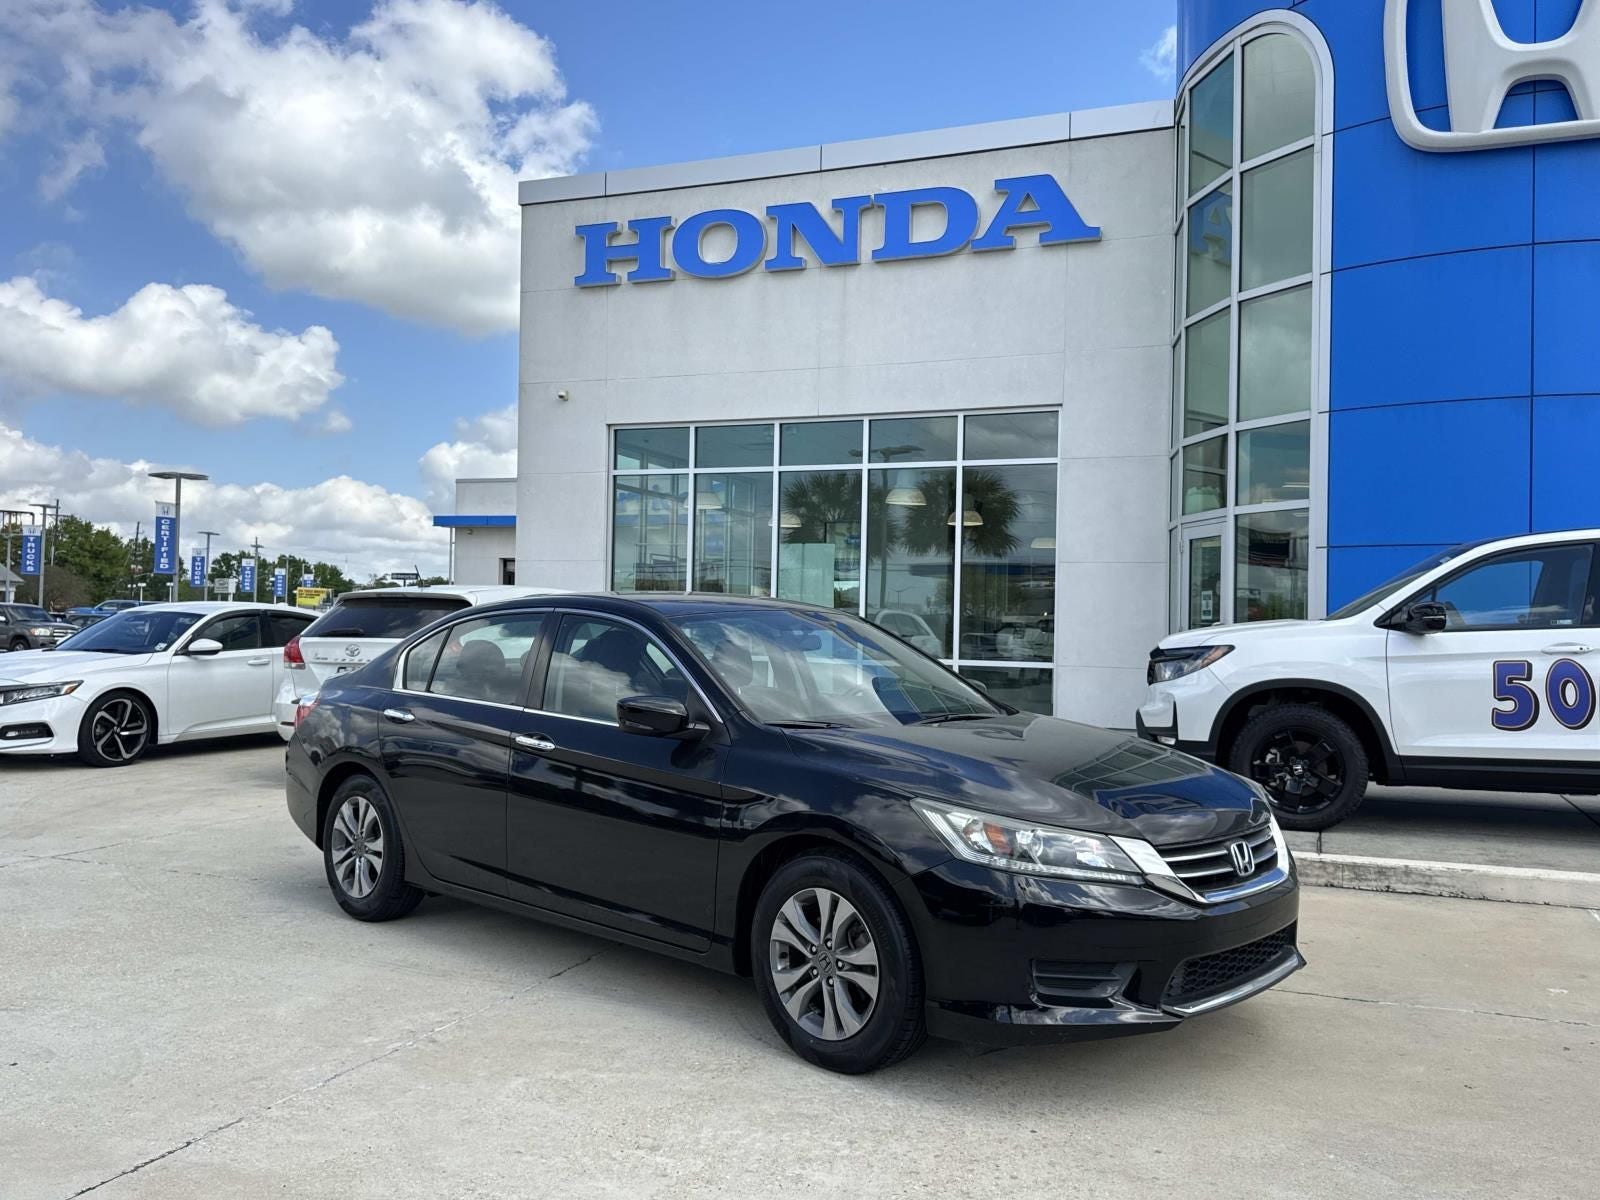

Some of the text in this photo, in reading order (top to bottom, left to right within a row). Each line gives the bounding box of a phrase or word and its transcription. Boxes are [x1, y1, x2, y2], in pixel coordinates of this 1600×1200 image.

[575, 173, 1101, 288] HONDA
[26, 537, 36, 572] TRUCKS
[160, 519, 170, 569] CERTIFIED
[1491, 658, 1597, 731] 50
